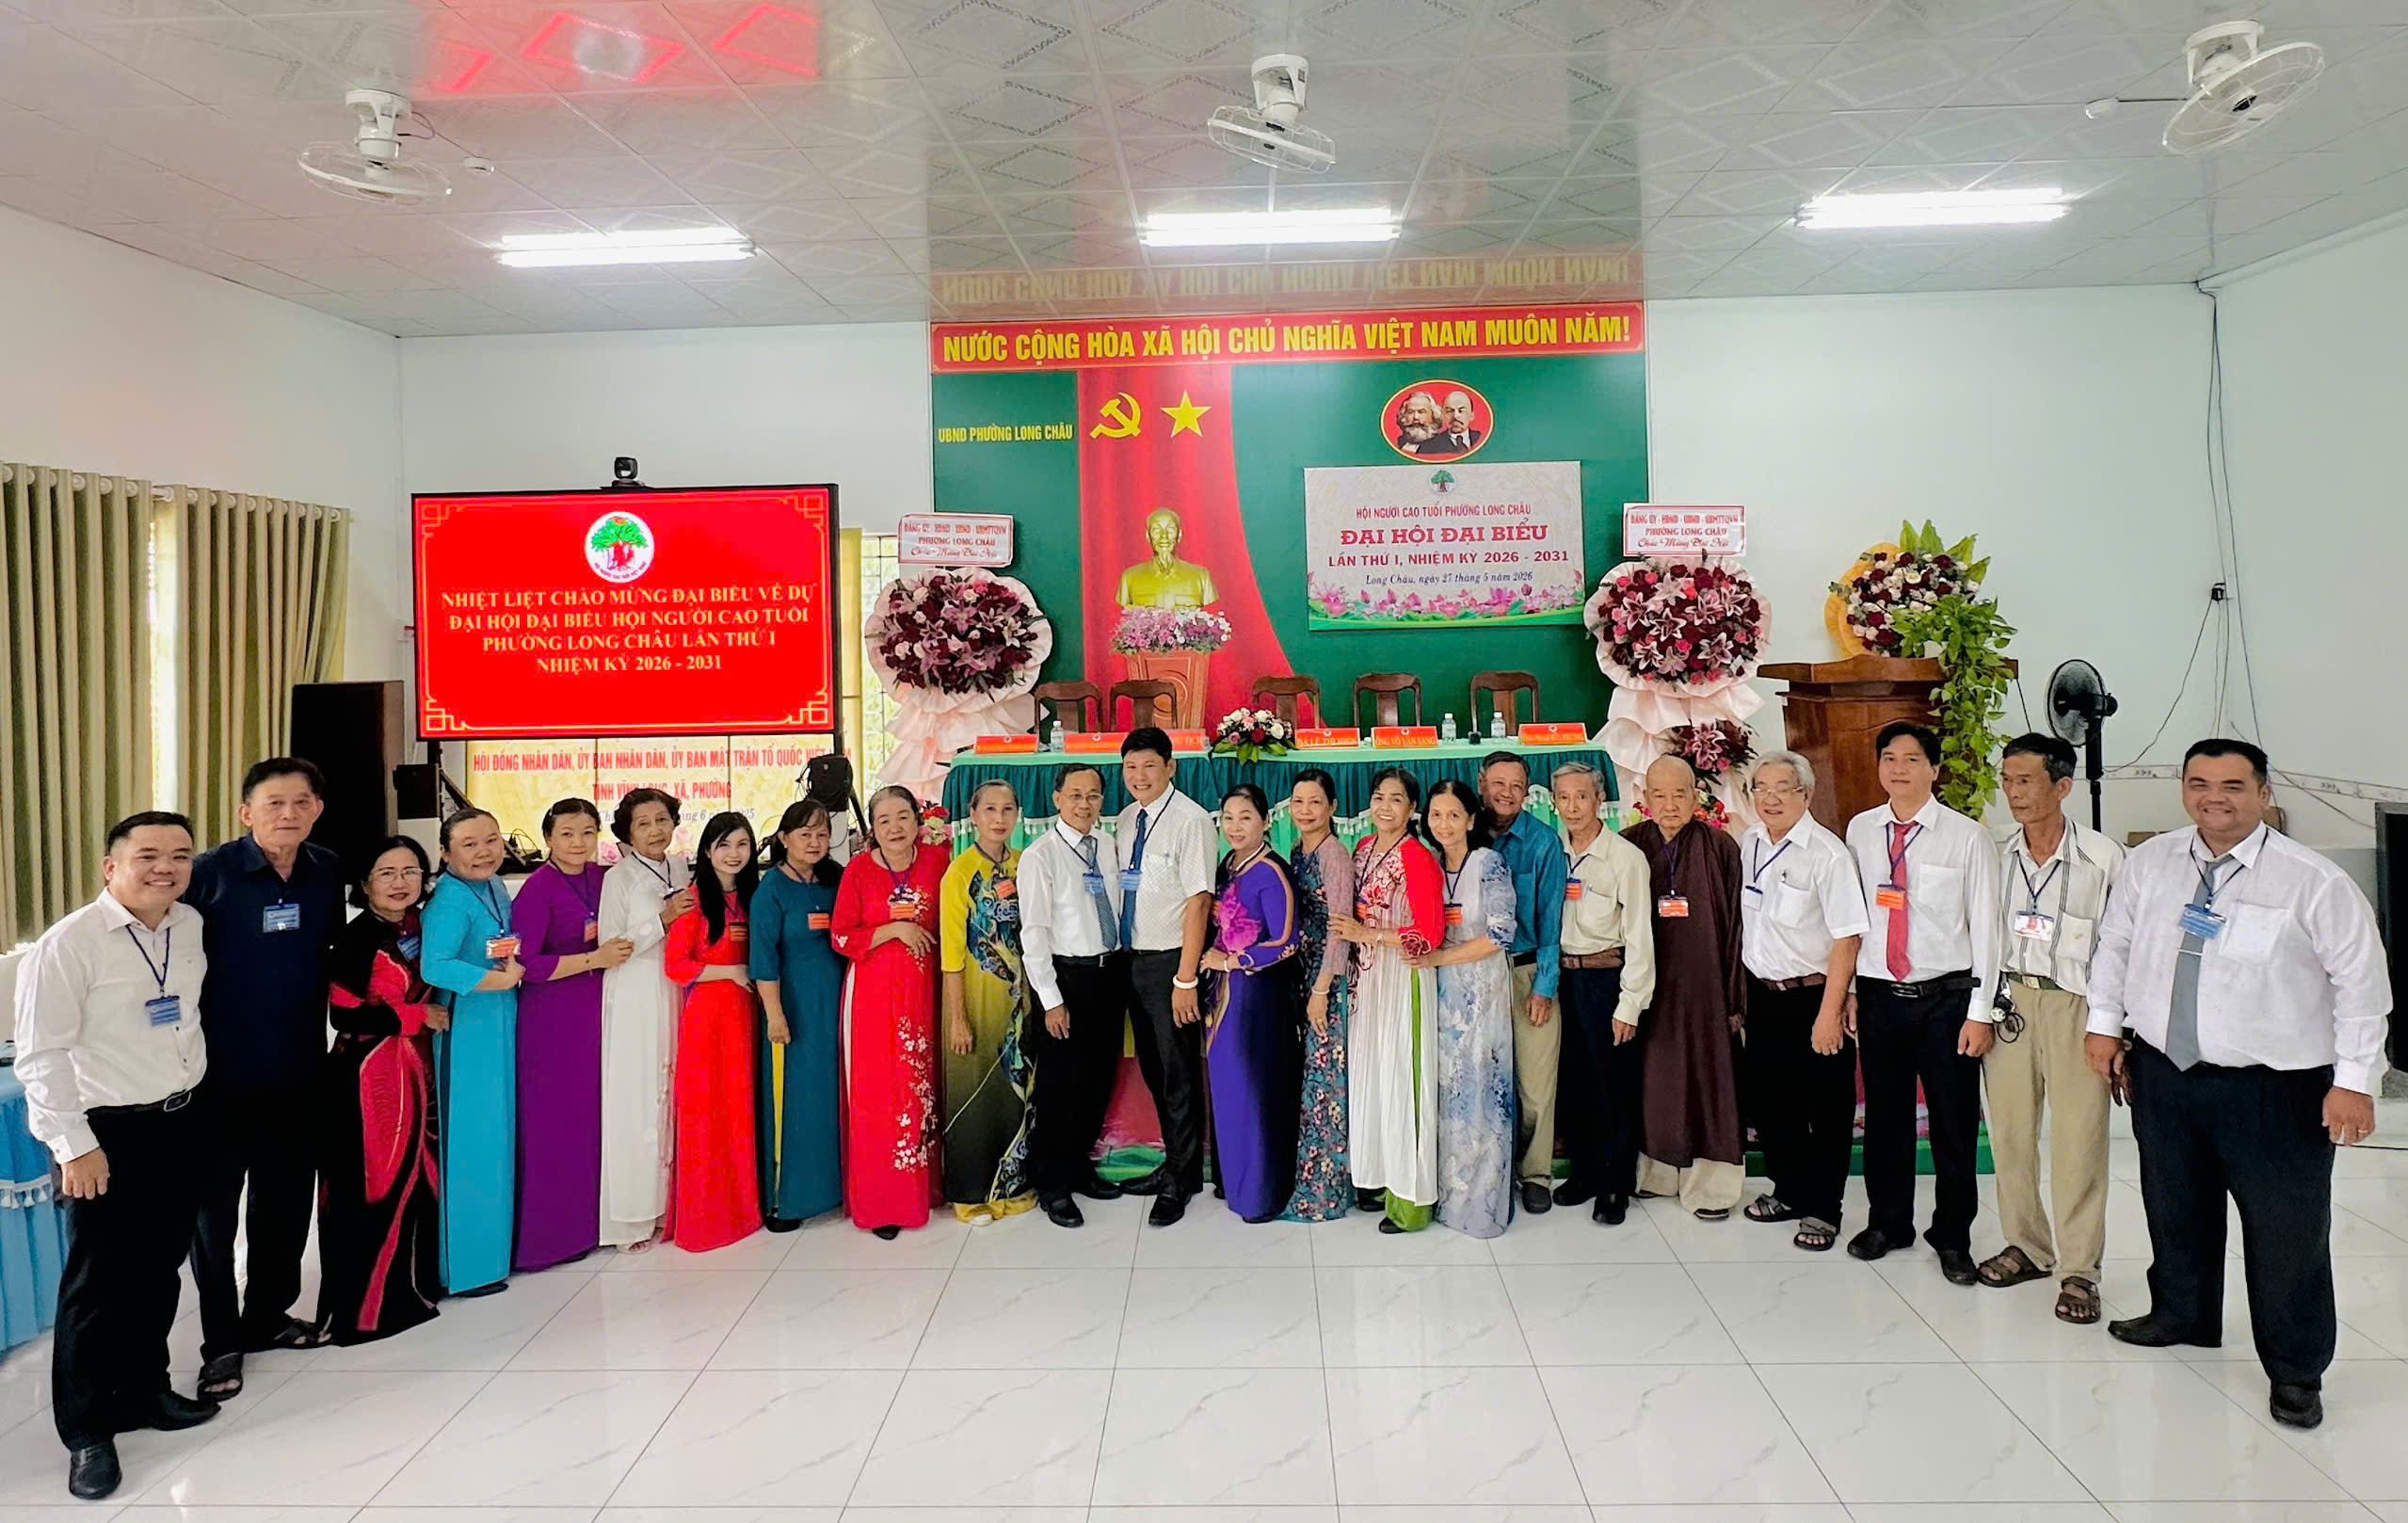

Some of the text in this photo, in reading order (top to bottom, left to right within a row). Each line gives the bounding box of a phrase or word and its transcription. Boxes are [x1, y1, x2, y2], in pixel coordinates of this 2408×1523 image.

[943, 312, 1630, 365] NƯỚC CỘNG HÒA XÃ HỘI CHỦ NGHĨA VIỆT NAM MUÔN NĂM!
[939, 422, 1073, 442] UBND PHƯỜNG LONG CHÂU
[1357, 505, 1372, 520] HỘI
[1403, 506, 1420, 518] CAO
[1483, 504, 1505, 516] LONG
[1340, 517, 1548, 548] ĐẠI HỘI ĐẠI BIỂU
[1360, 551, 1390, 566] THỨ
[1394, 553, 1403, 567] I,
[1408, 551, 1453, 567] NHIỆM
[1484, 551, 1519, 563] 2026
[1533, 551, 1568, 562] 2031
[1366, 574, 1388, 586] Long
[1442, 572, 1453, 583] 27
[1483, 571, 1488, 582] 5
[1513, 570, 1533, 582] 2026
[441, 591, 500, 610] NHIỆT
[504, 590, 546, 610] LIỆT
[672, 587, 704, 607] ĐẠI
[449, 614, 482, 633] ĐẠI
[487, 612, 520, 633] HỘI
[613, 611, 646, 630] HỘI
[717, 609, 759, 624] CAO
[567, 635, 618, 650] LONG
[623, 629, 676, 649] CHÂU
[769, 631, 776, 646] I
[537, 656, 599, 676] NHIỆM
[635, 655, 671, 671] 2026
[686, 654, 722, 670] 2031
[593, 752, 613, 769] BAN
[686, 750, 706, 768] BAN
[700, 810, 707, 821] 6
